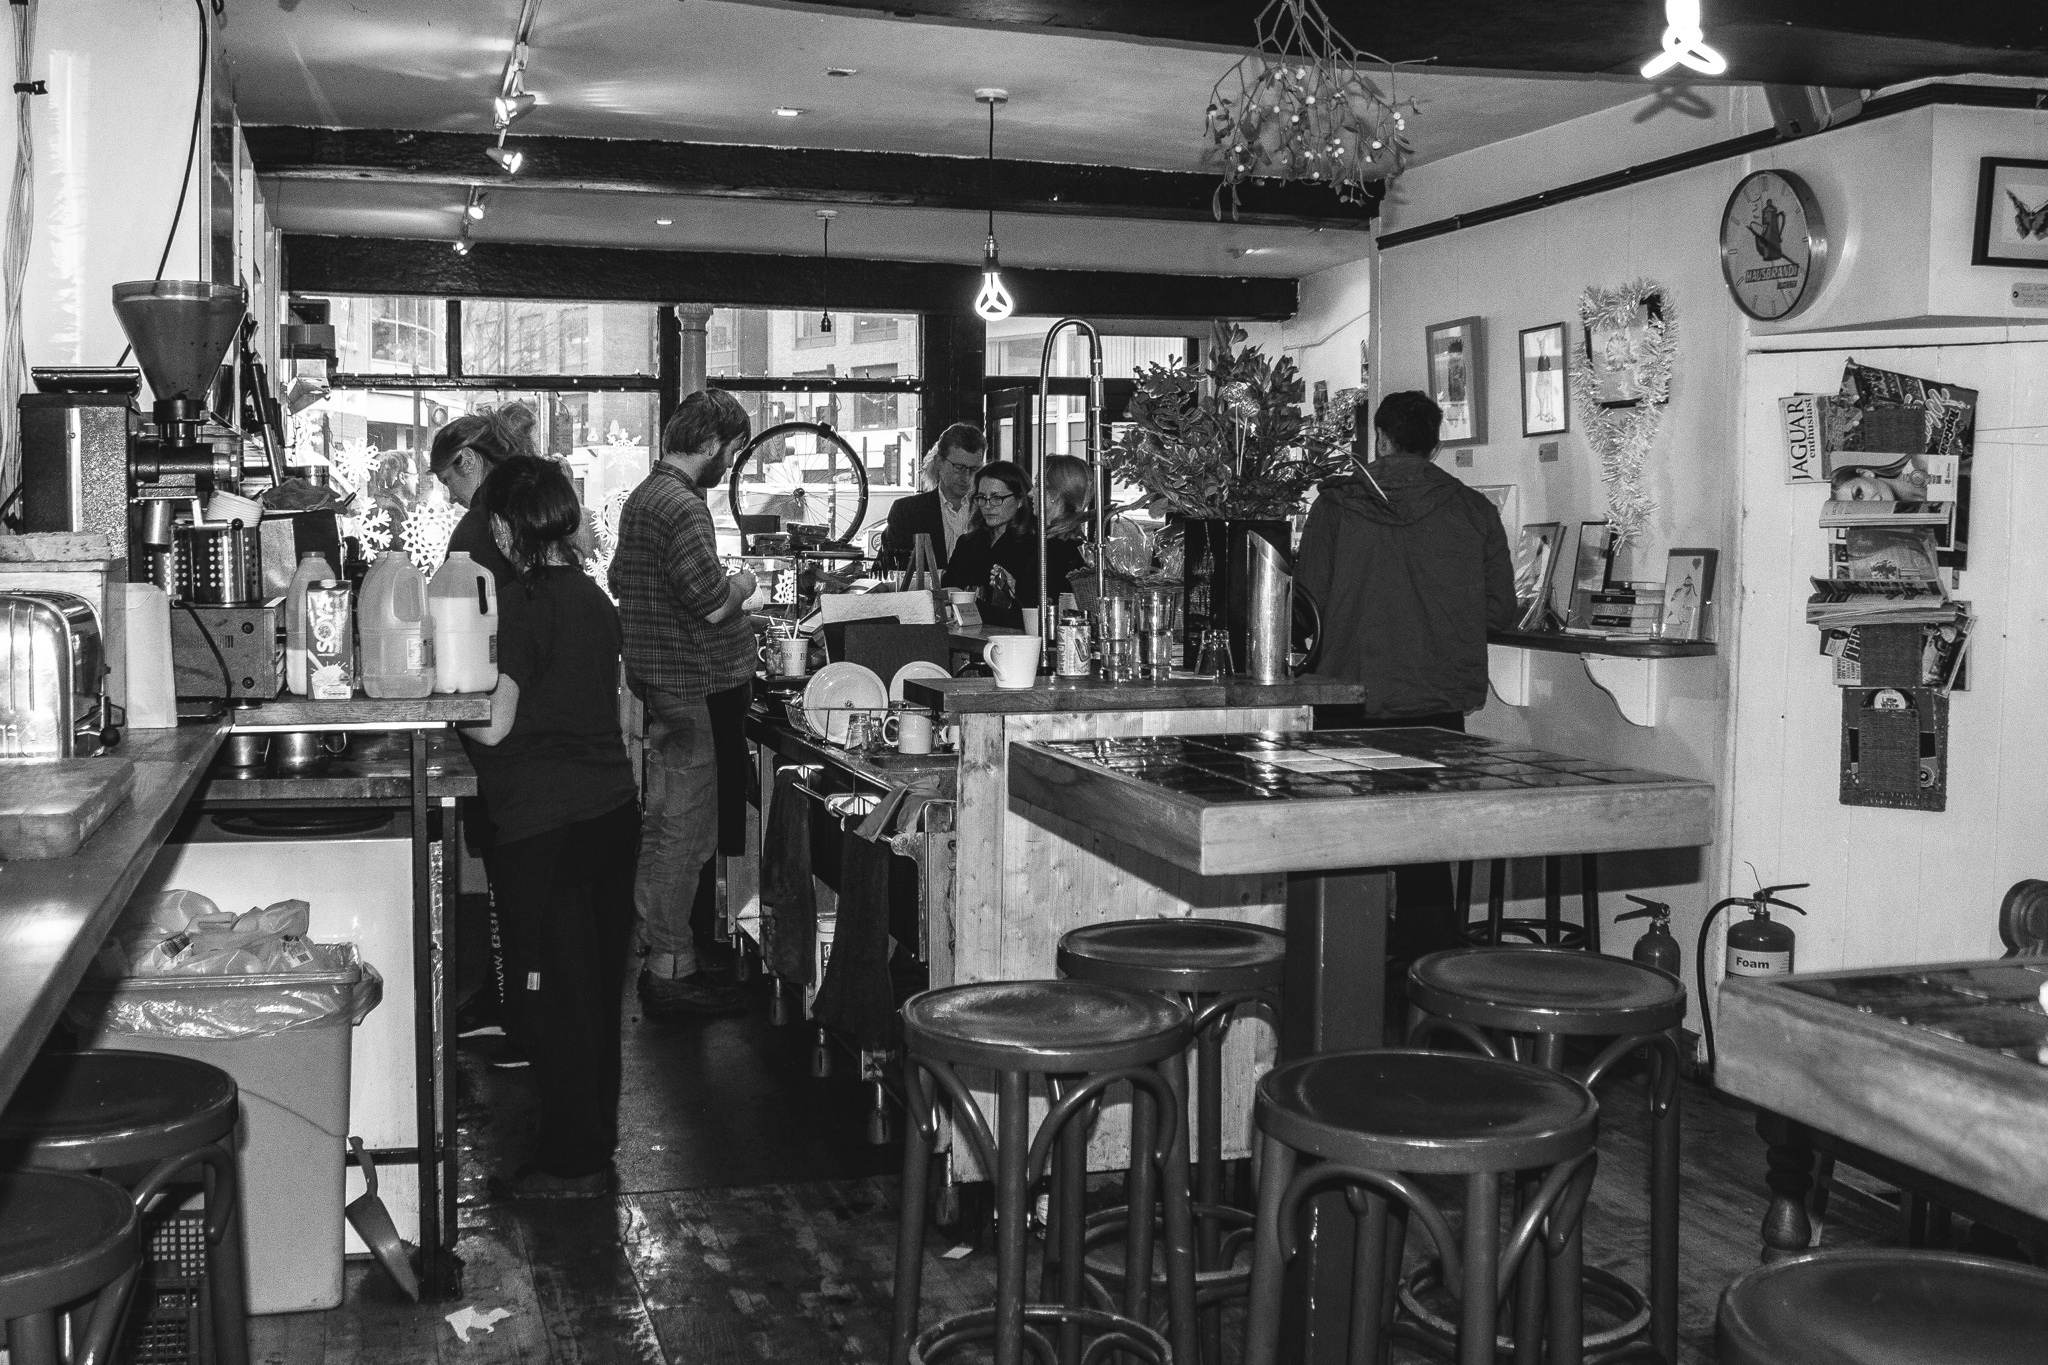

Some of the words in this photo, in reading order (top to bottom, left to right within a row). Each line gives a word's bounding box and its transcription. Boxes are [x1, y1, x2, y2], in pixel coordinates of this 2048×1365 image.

[1786, 400, 1813, 480] JAGUAR
[1804, 398, 1816, 458] enthusiast
[1736, 956, 1769, 969] Foam
